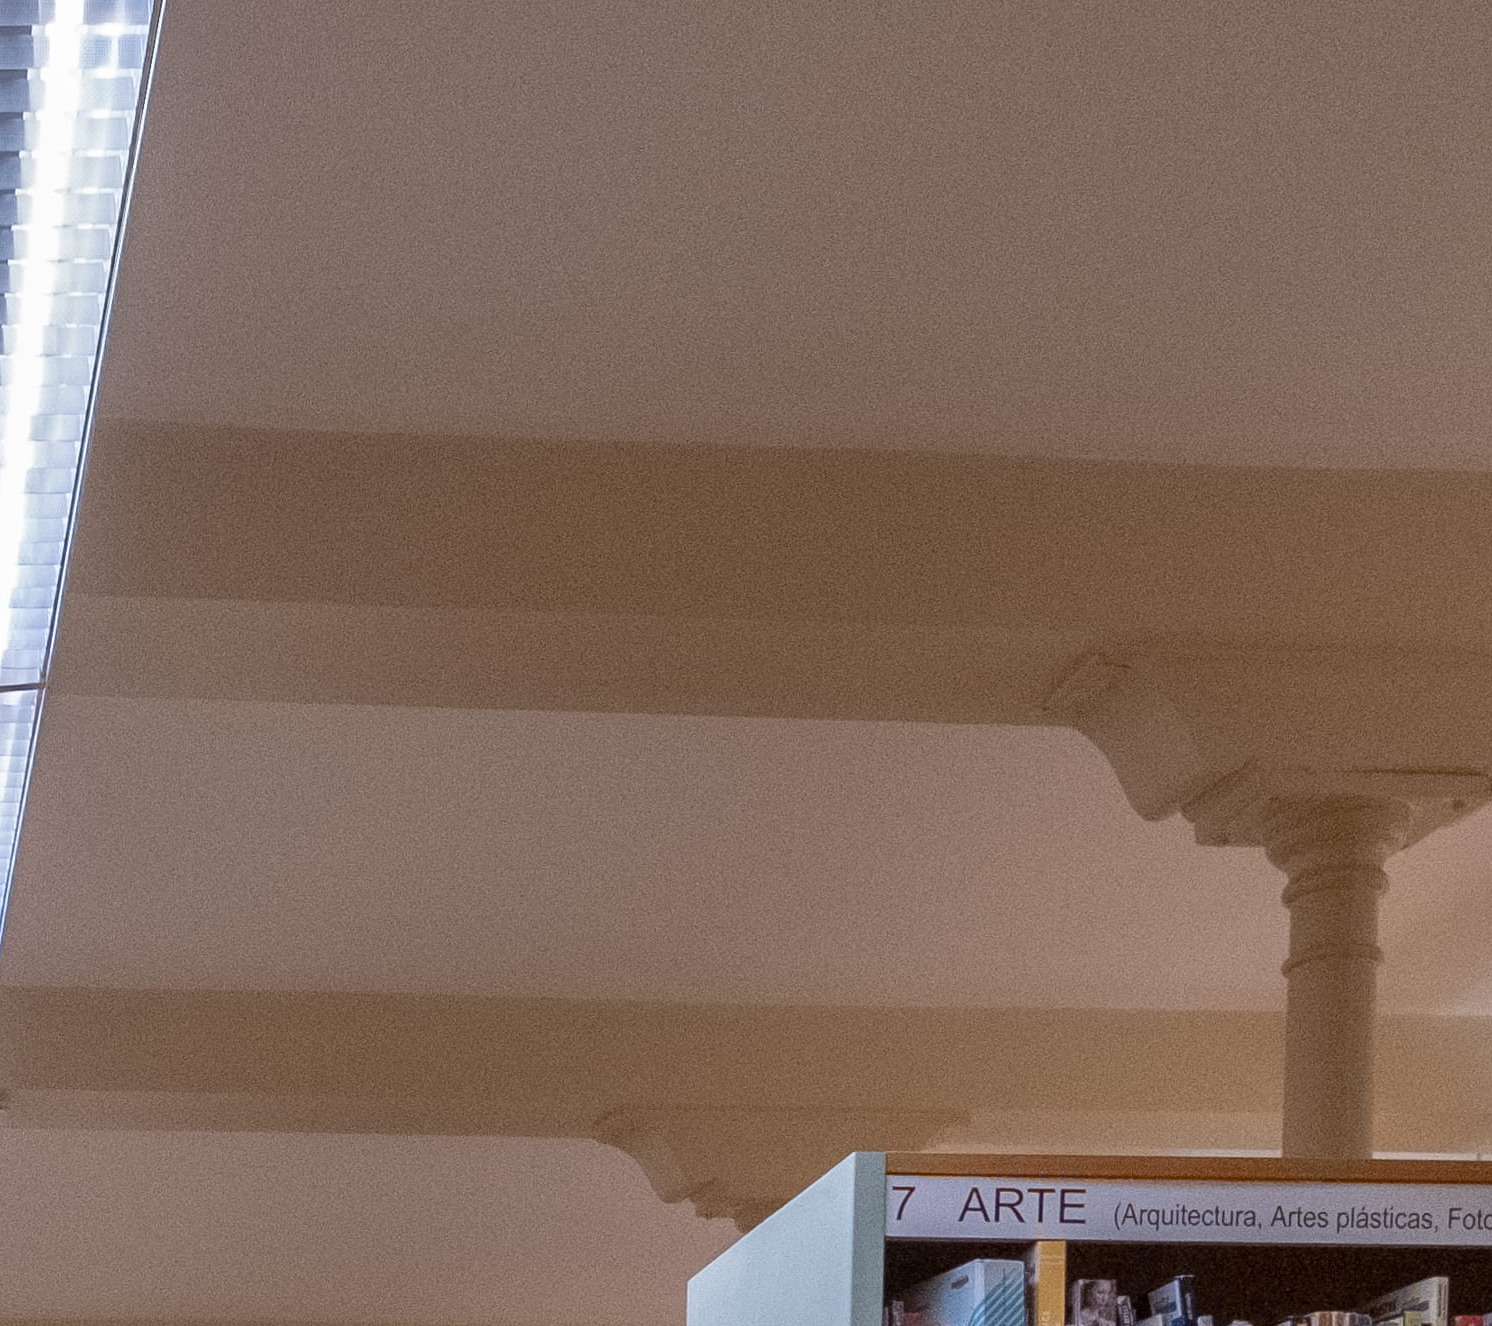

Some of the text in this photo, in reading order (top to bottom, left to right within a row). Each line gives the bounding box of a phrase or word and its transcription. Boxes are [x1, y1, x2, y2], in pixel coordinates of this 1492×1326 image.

[891, 1186, 916, 1221] 7
[958, 1186, 1087, 1225] ARTE
[1113, 1202, 1263, 1231] (Arquitectura,
[1270, 1205, 1329, 1229] Artes
[1336, 1206, 1439, 1234] plásticas,
